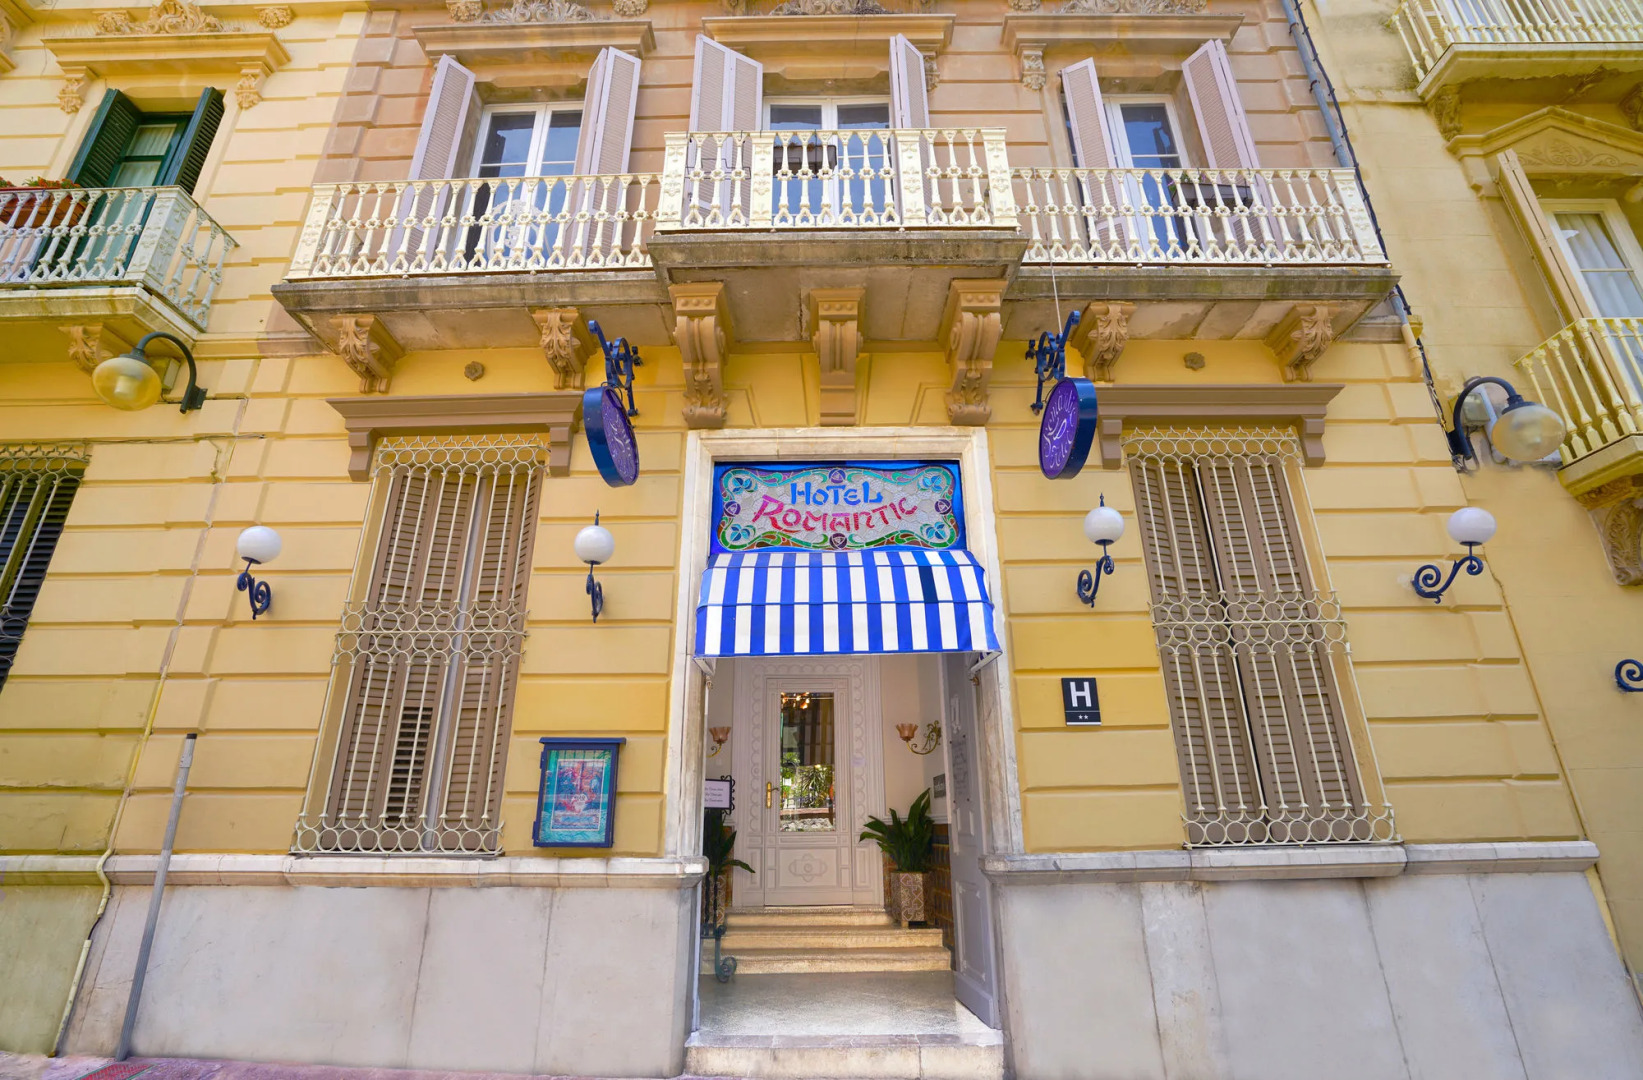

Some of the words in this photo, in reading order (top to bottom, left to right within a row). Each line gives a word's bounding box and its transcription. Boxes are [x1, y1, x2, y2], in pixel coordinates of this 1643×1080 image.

[790, 482, 883, 506] HOTEL
[753, 495, 918, 533] ROMANTIC
[1069, 681, 1092, 707] H
